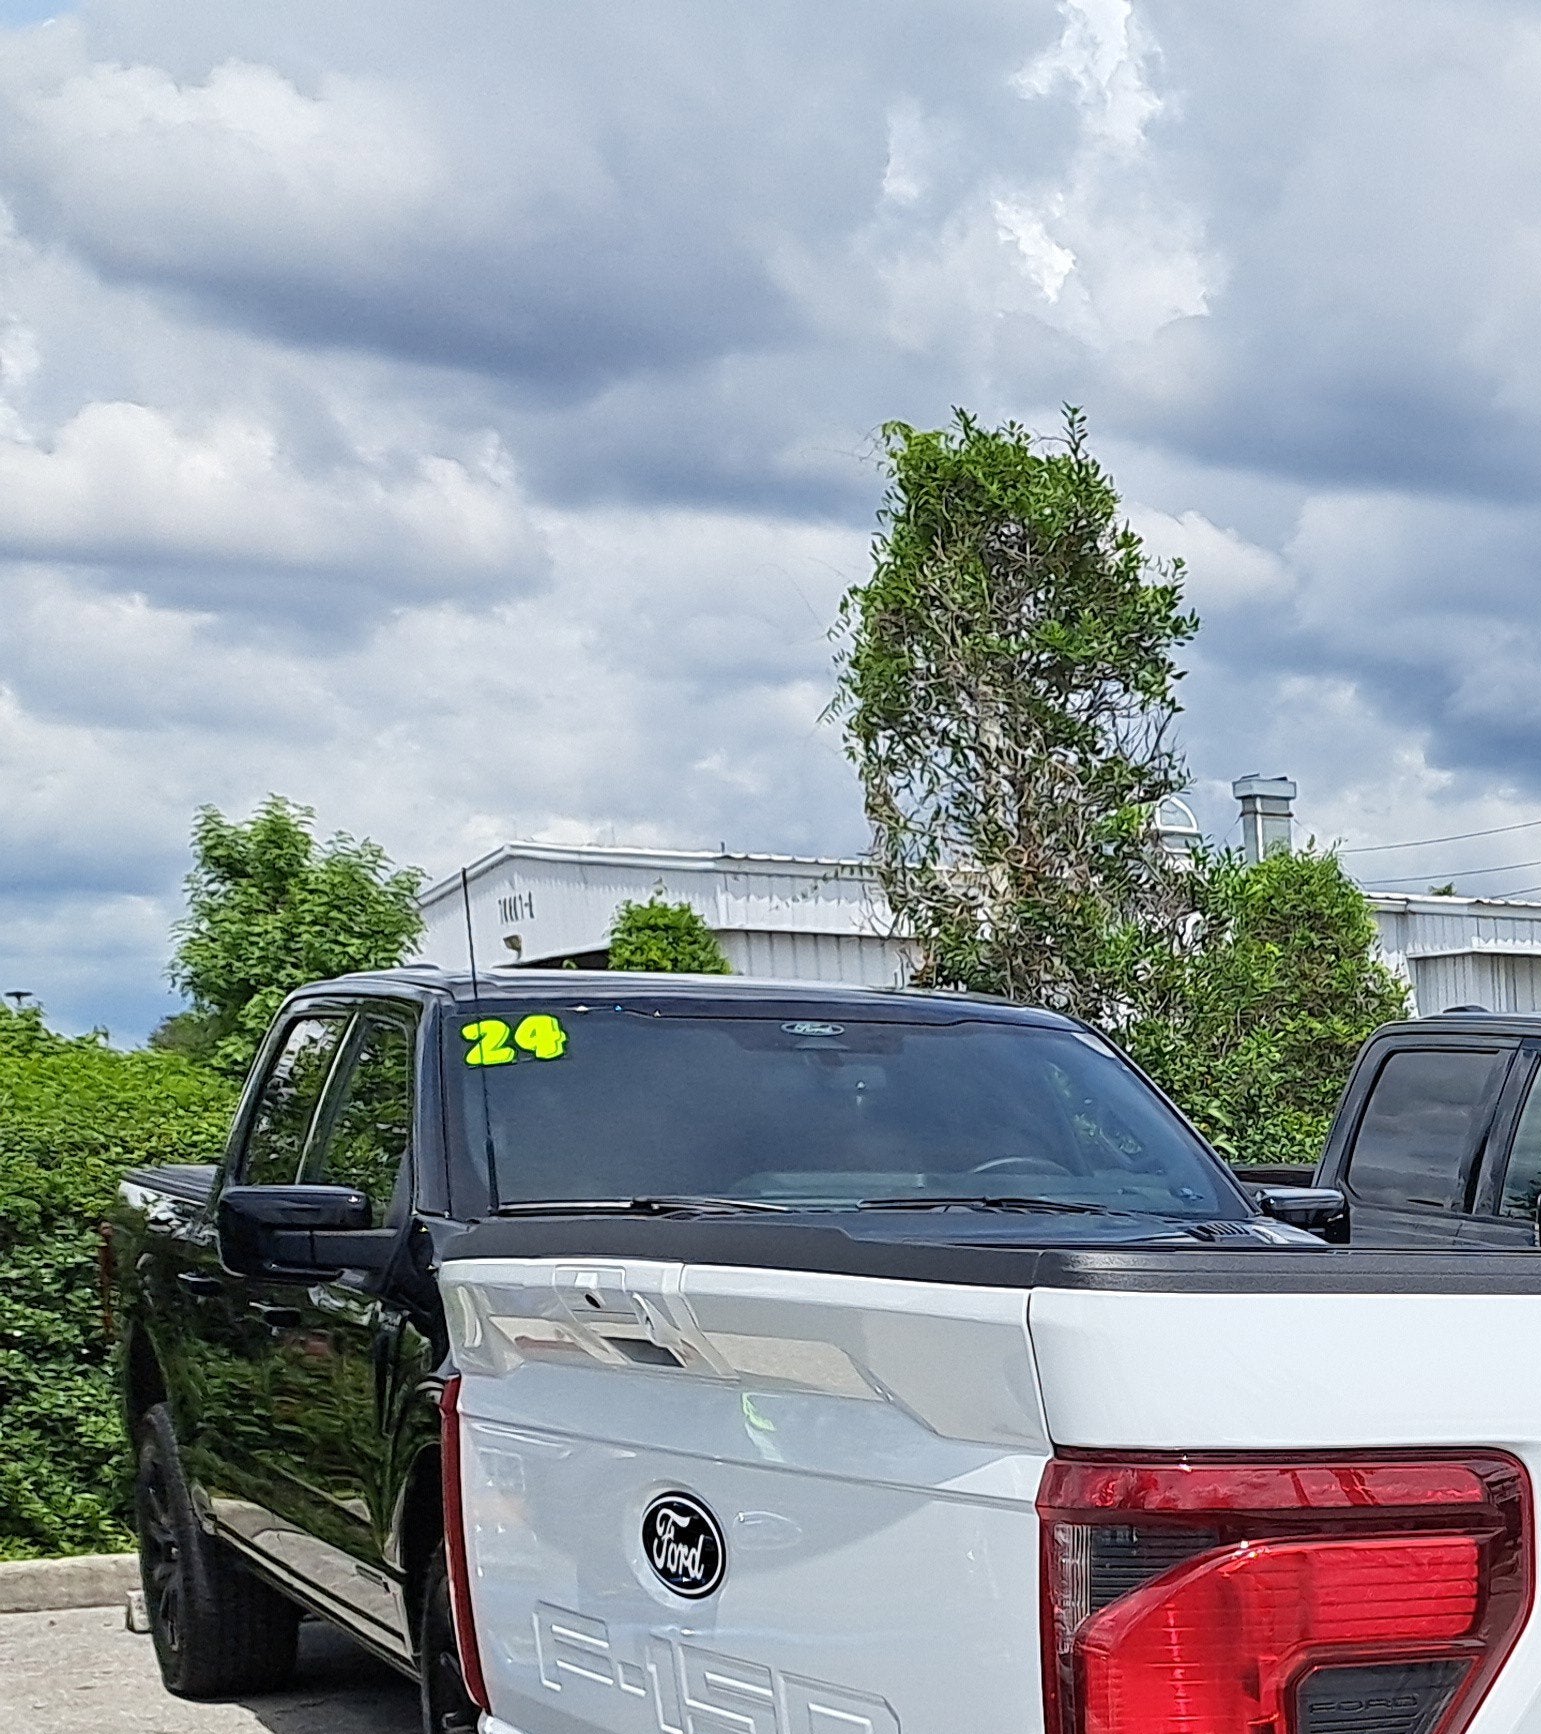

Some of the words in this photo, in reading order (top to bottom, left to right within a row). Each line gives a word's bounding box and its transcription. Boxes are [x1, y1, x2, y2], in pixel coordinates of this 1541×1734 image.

[461, 1013, 568, 1066] 24
[652, 1507, 706, 1585] Ford
[1308, 1693, 1420, 1715] FORD
